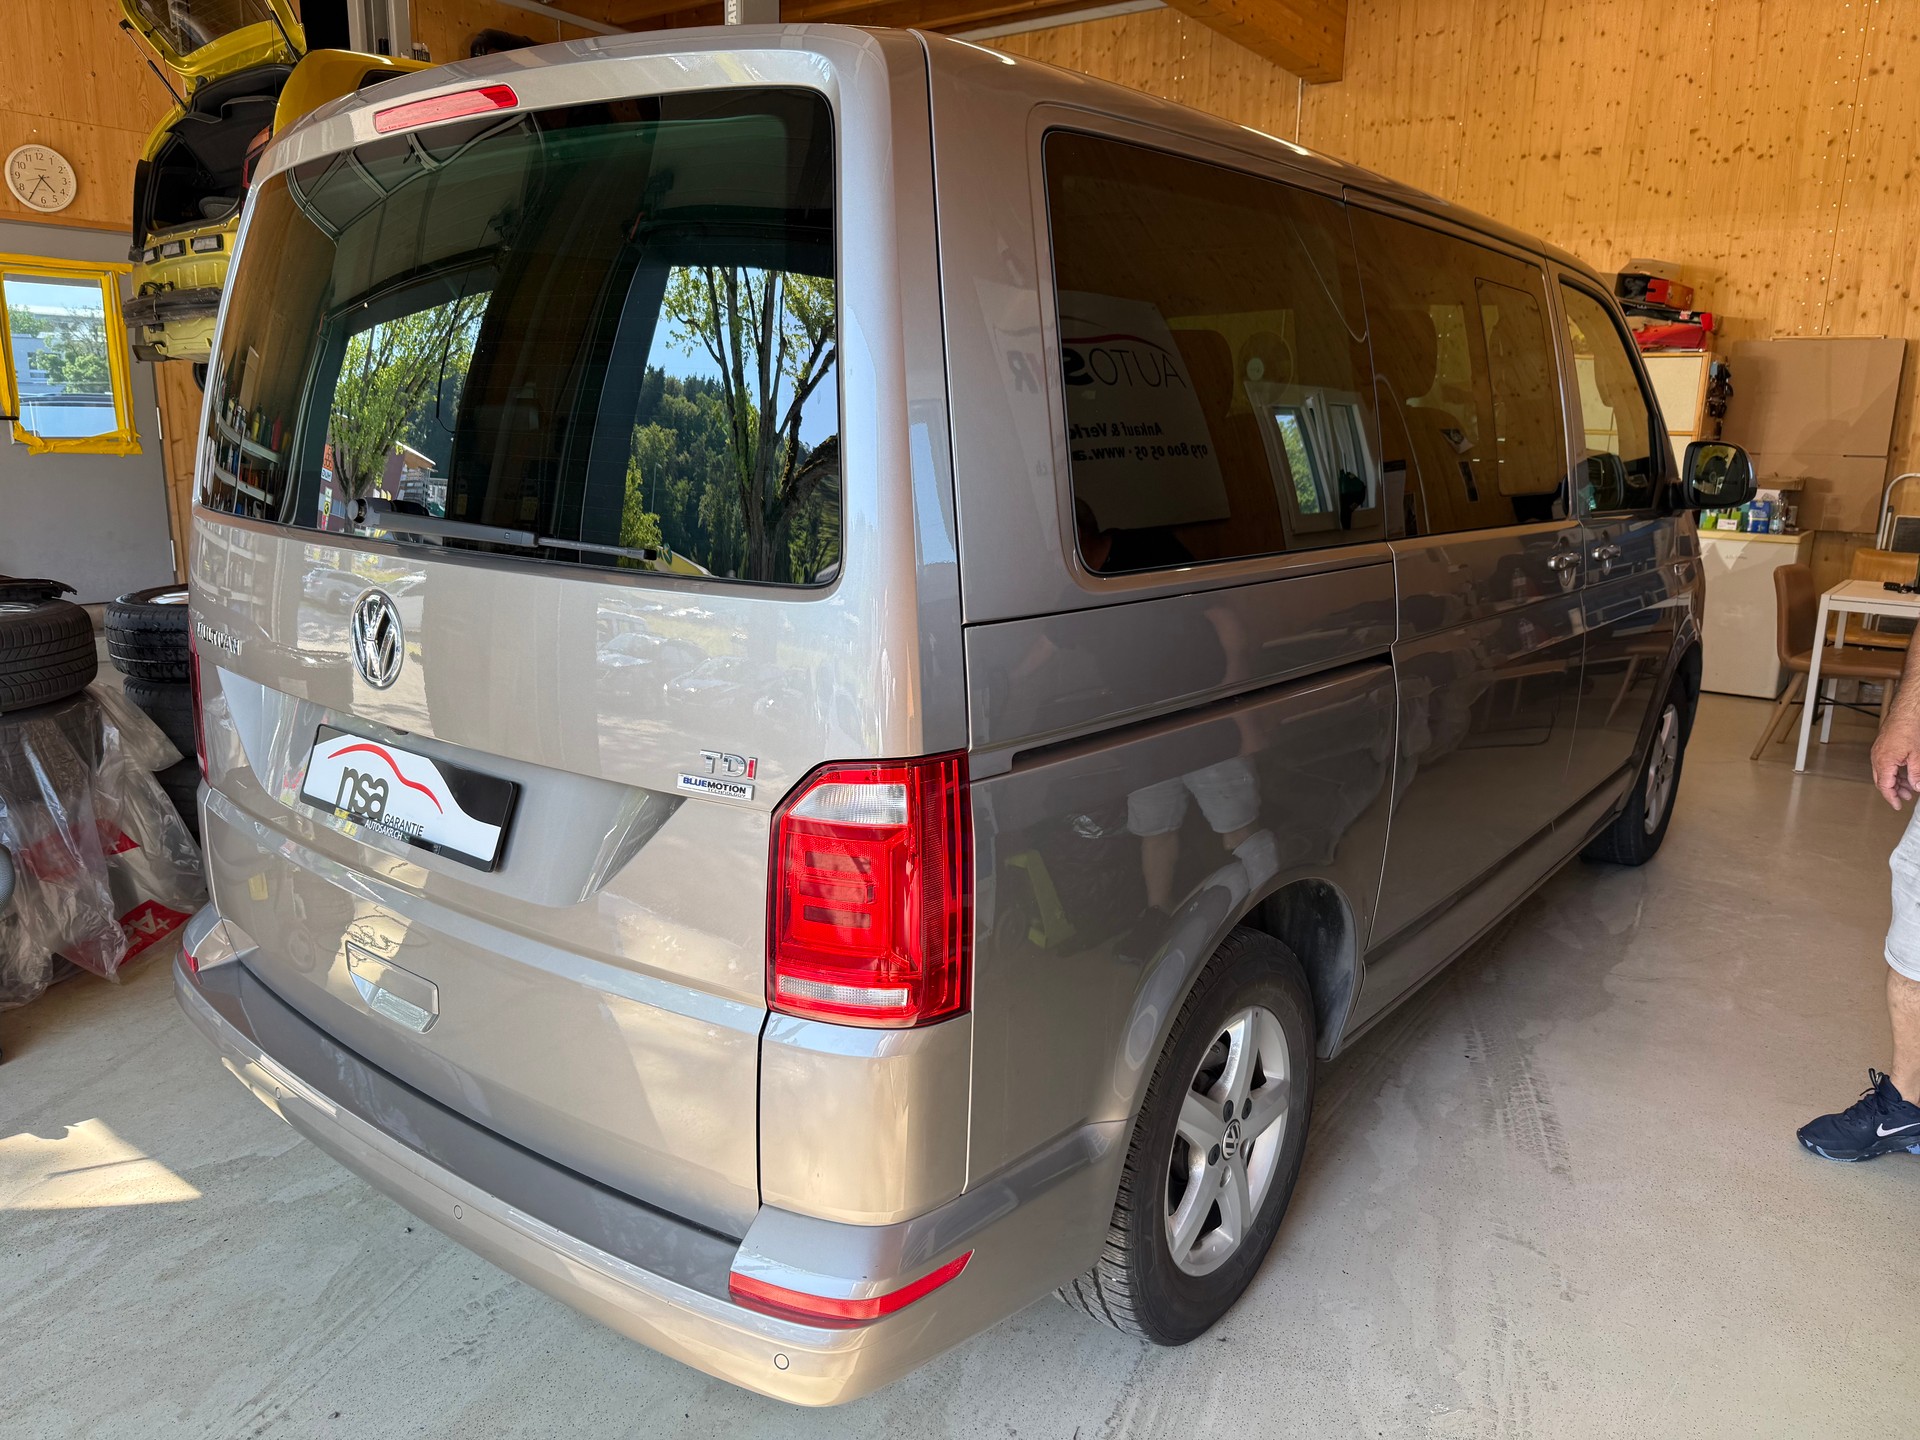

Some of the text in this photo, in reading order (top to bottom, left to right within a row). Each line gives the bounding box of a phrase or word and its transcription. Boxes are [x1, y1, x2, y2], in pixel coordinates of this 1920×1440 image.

[25, 154, 32, 162] 11
[35, 153, 44, 161] 12
[49, 157, 53, 166] 1
[16, 161, 26, 170] 10
[58, 166, 64, 174] 2
[15, 171, 21, 179] 9
[62, 177, 67, 186] 3
[19, 183, 25, 191] 8
[41, 196, 47, 205] 6
[52, 195, 58, 203] 5
[700, 749, 758, 780] TDI
[683, 777, 746, 794] BLUEMOTION
[335, 766, 389, 821] nsa
[384, 813, 424, 836] GARANTIE
